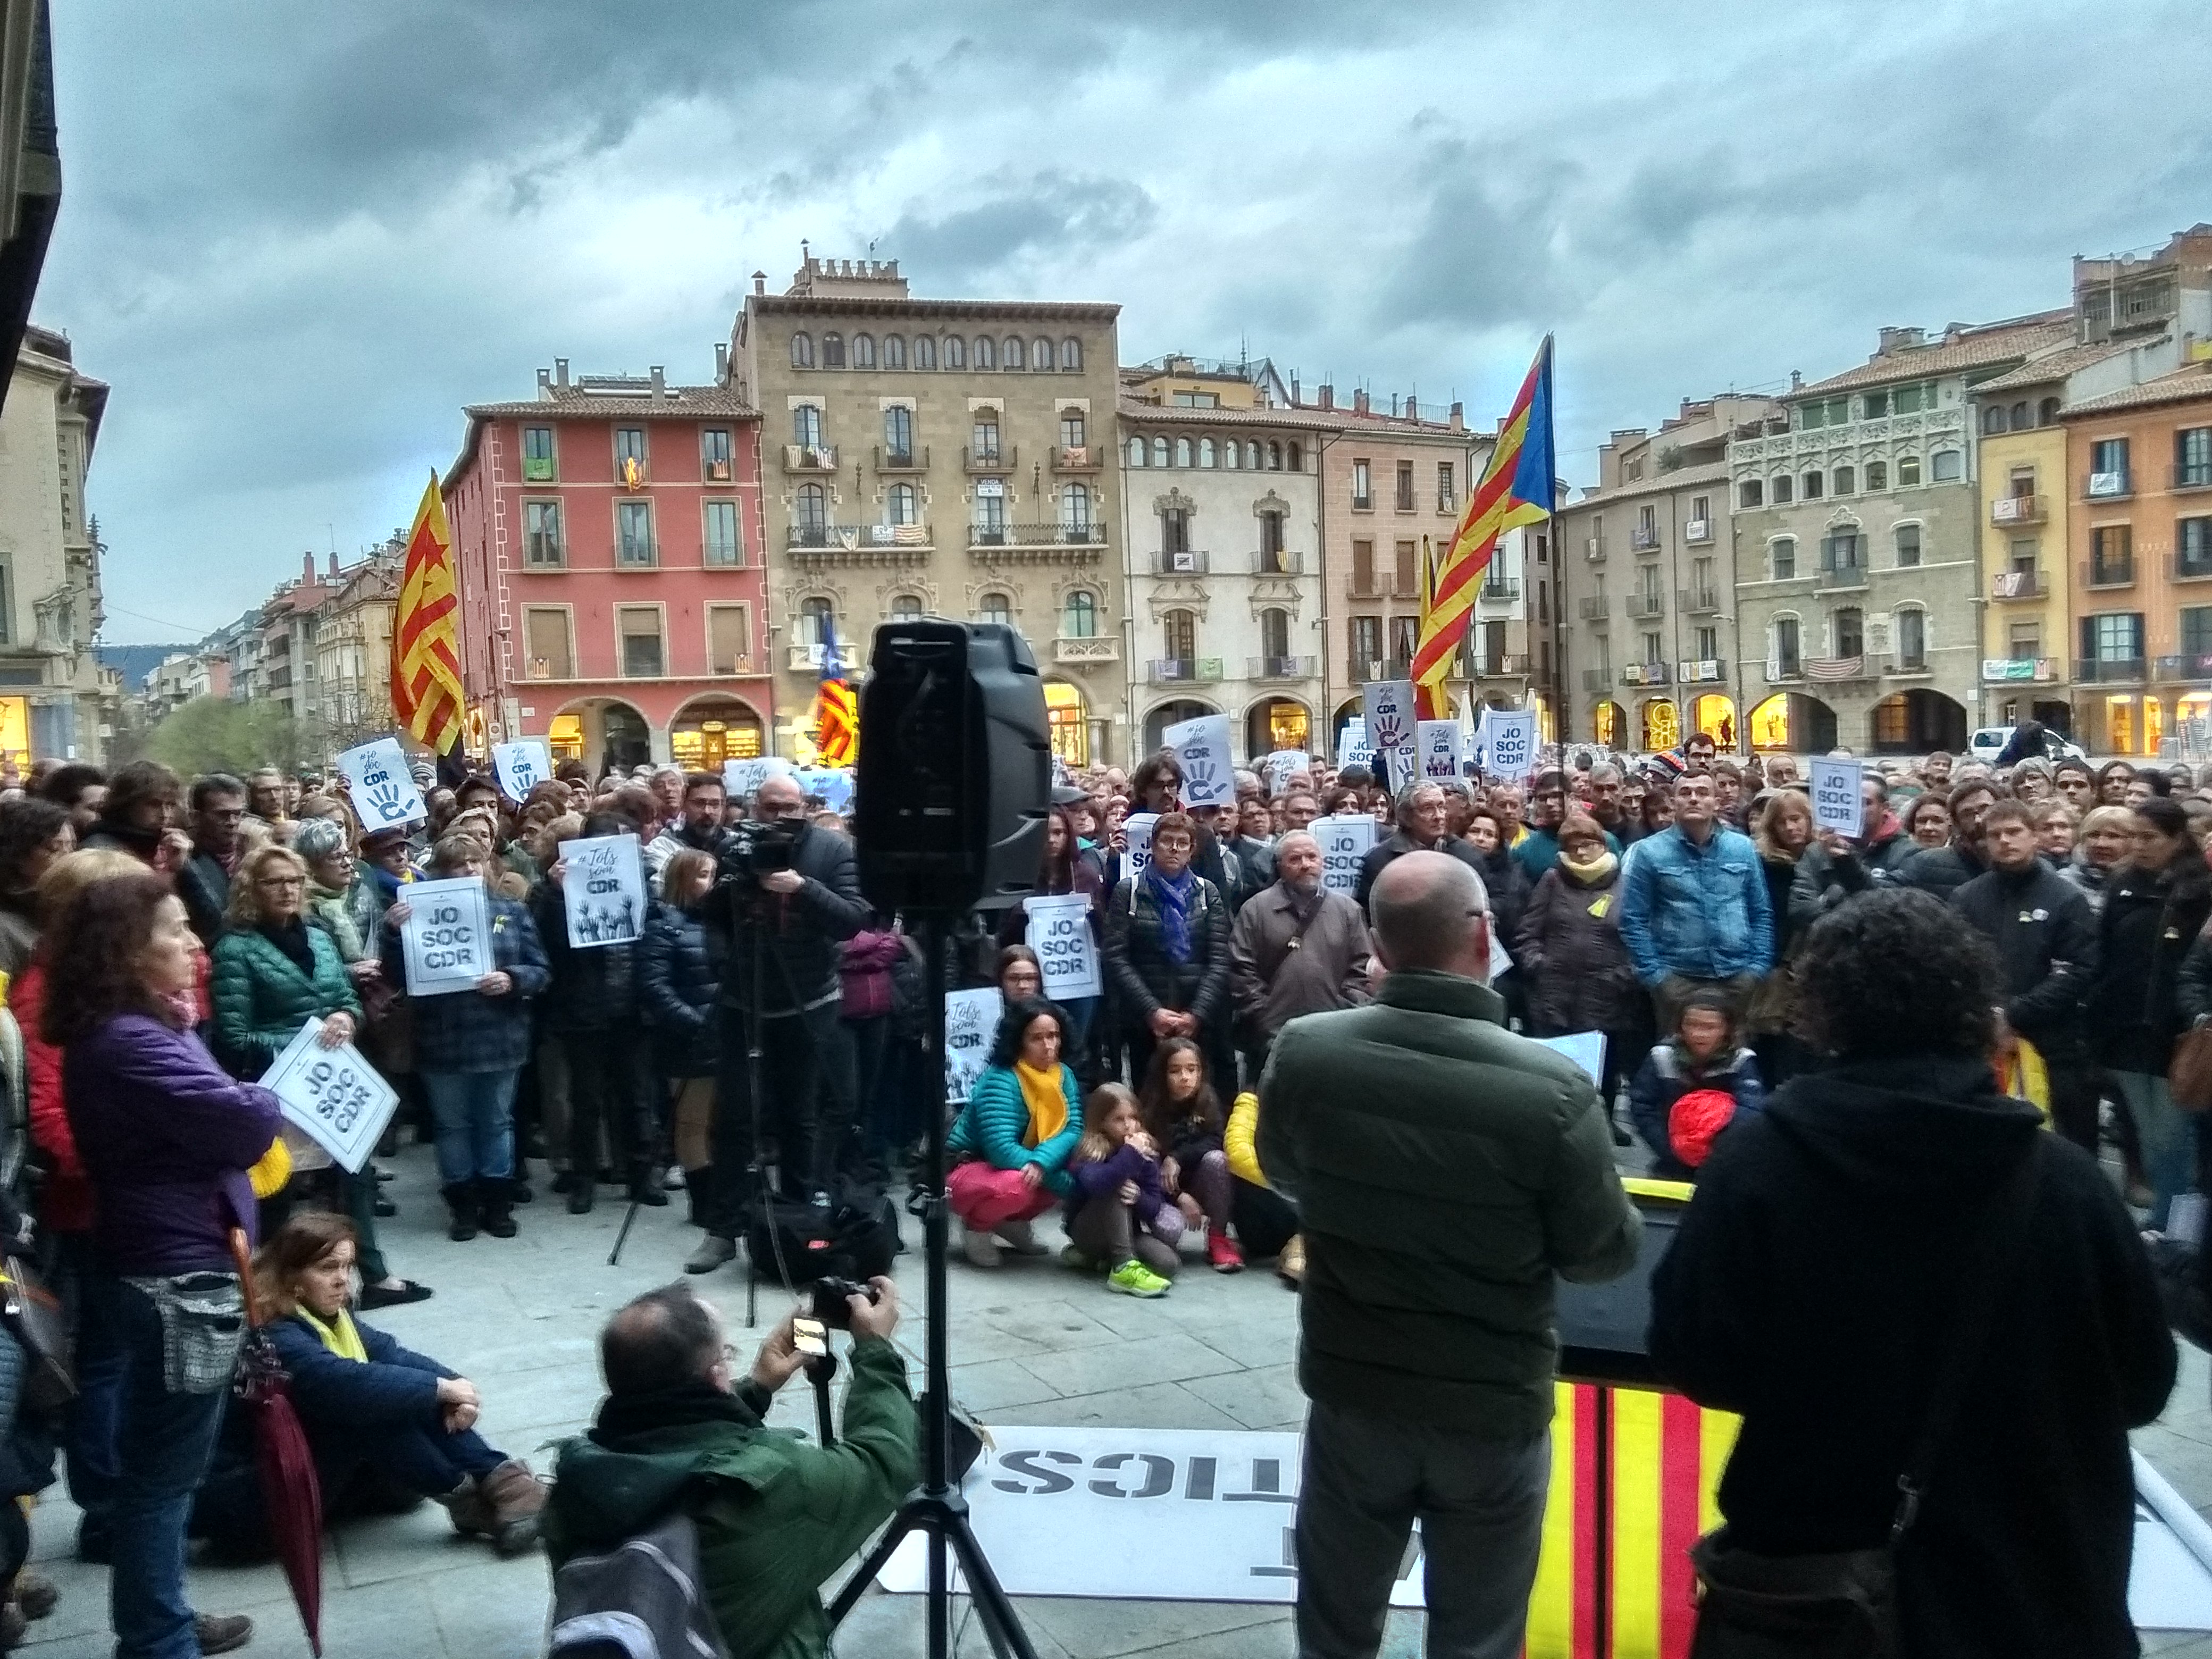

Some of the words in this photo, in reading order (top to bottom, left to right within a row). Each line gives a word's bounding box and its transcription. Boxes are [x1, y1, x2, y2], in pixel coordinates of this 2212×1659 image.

[1377, 705, 1397, 714] CDR
[1502, 727, 1521, 739] JO
[1184, 747, 1210, 759] CDR
[1496, 740, 1526, 751] SOC
[359, 750, 376, 765] #jo
[1497, 753, 1523, 764] CDR
[512, 763, 532, 774] CDR
[363, 771, 390, 786] CDR
[1824, 775, 1844, 789] JO
[1818, 790, 1853, 805] SOC
[1819, 806, 1851, 820] CDR
[1330, 837, 1354, 852] JO
[577, 847, 618, 866] #Tots
[1323, 855, 1365, 870] SOC
[586, 878, 621, 894] CDR
[428, 906, 459, 925] JO
[1048, 919, 1073, 936] JO
[421, 926, 472, 948] SOC
[1041, 937, 1083, 956] SOC
[424, 948, 474, 969] CDR
[1043, 958, 1086, 975] CDR
[949, 1033, 984, 1049] CDR
[304, 1061, 333, 1095] JO
[316, 1068, 356, 1120] SOC
[334, 1085, 372, 1133] CDR
